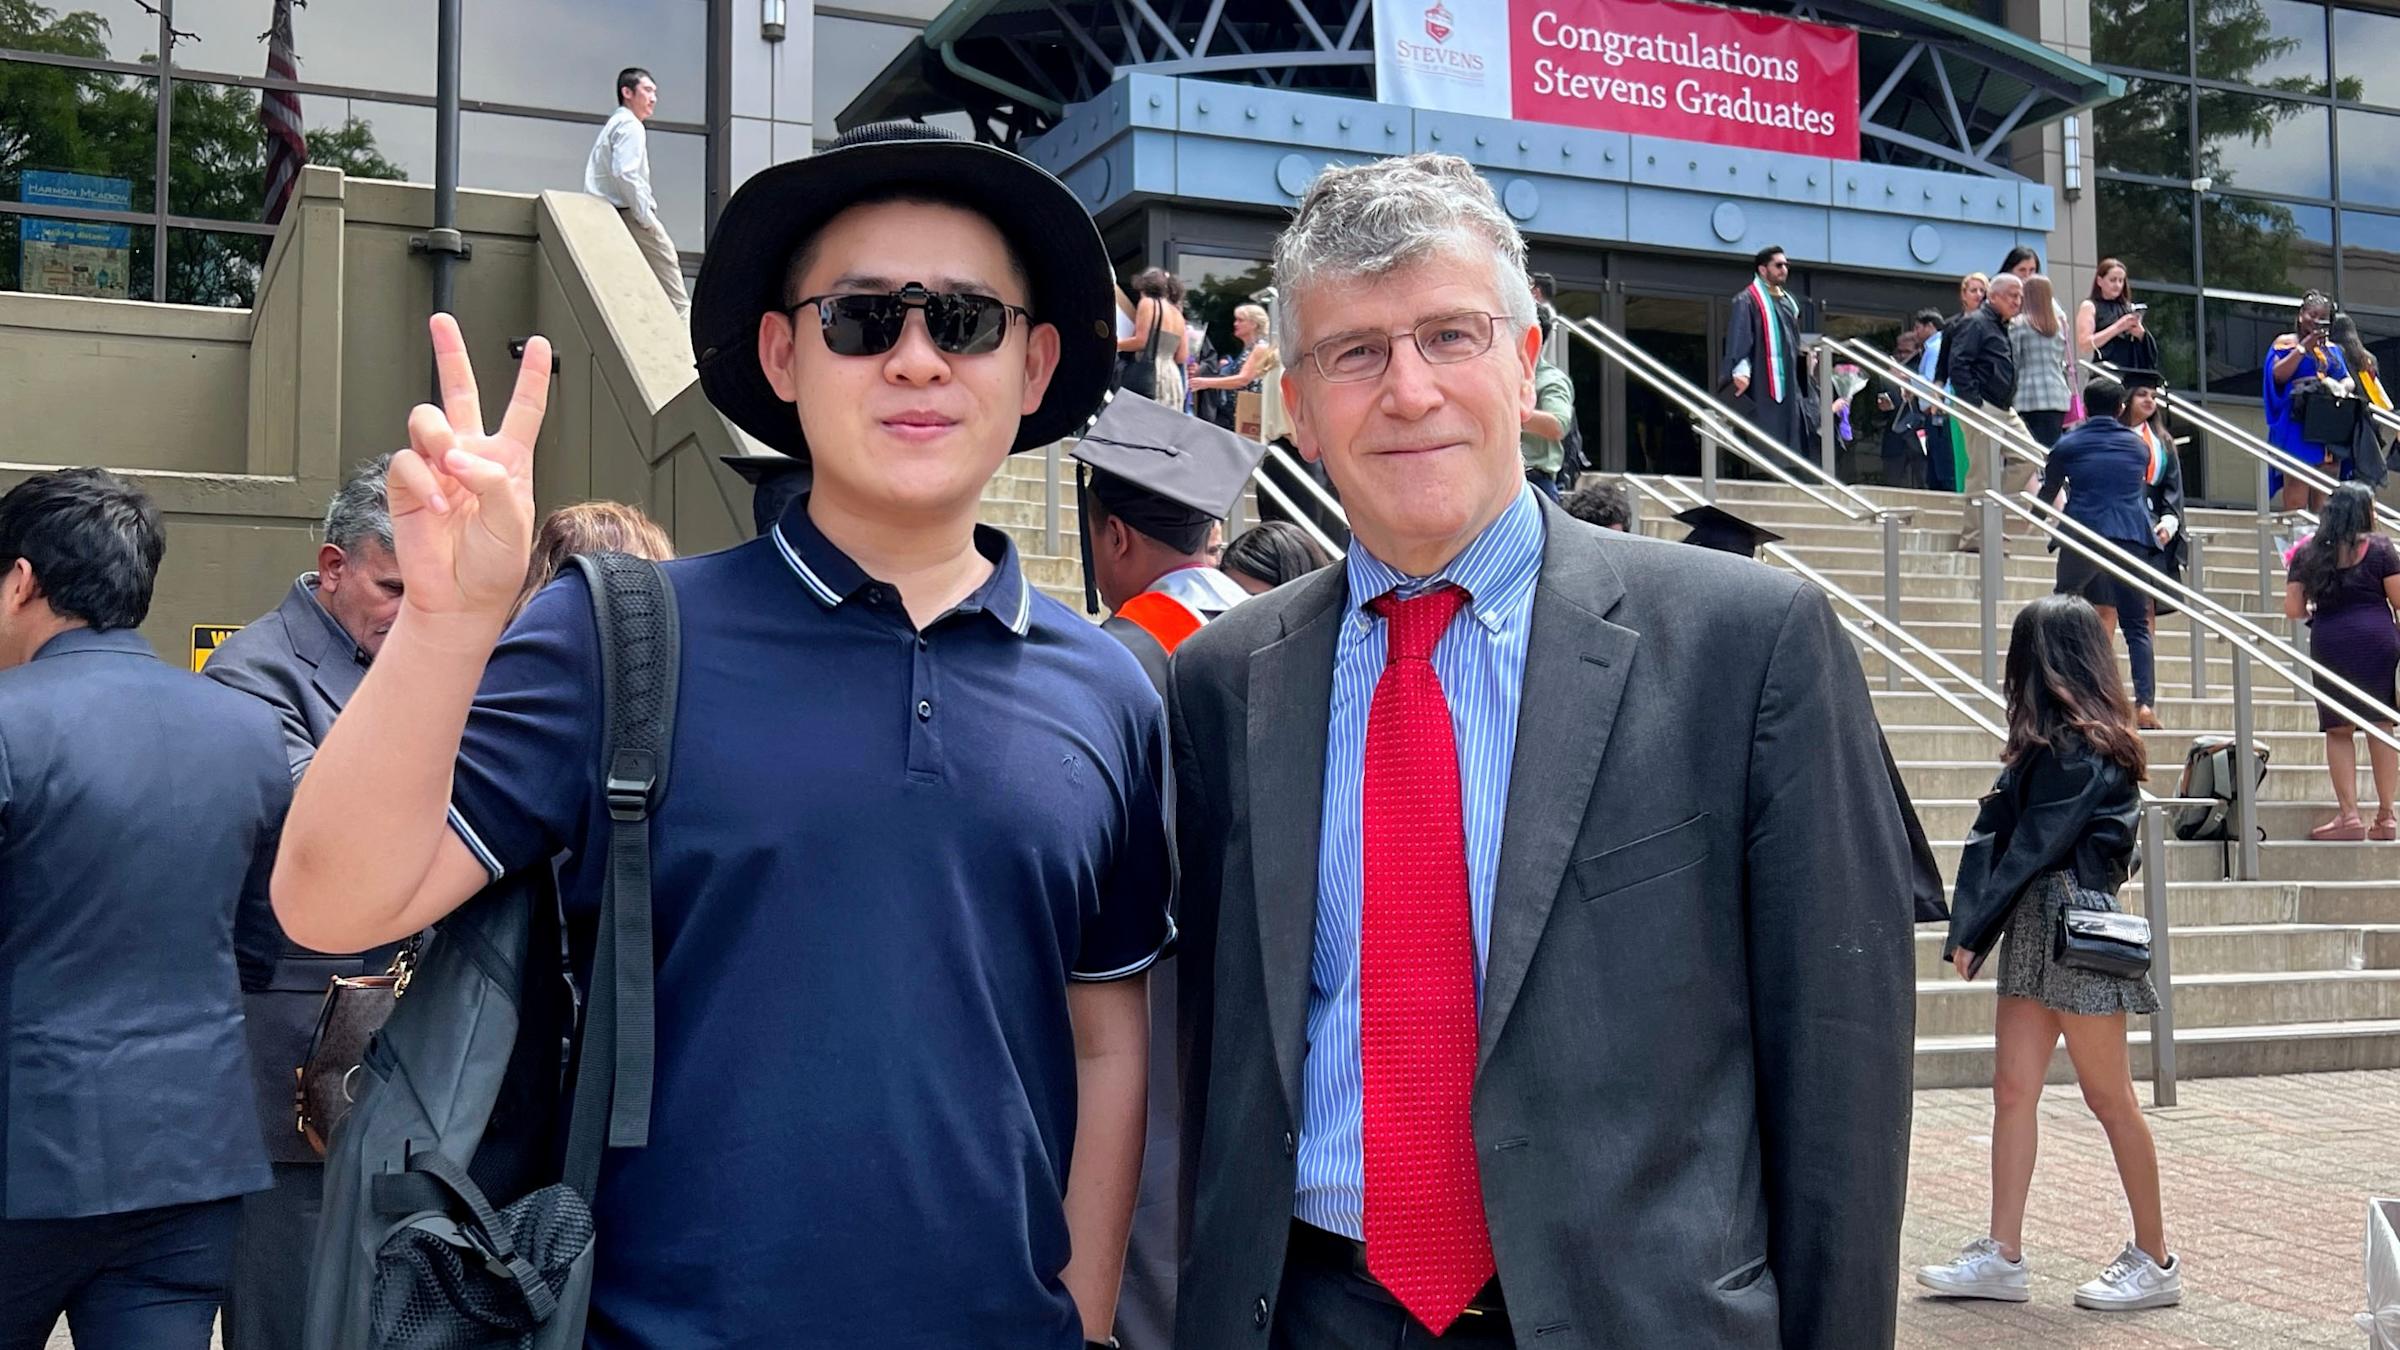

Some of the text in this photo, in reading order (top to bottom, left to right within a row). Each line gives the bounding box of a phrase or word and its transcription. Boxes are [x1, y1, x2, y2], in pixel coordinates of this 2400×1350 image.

[1397, 40, 1484, 70] STEVENS
[1532, 10, 1800, 83] Congratulations
[1534, 59, 1836, 136] Stevens Graduates
[29, 184, 128, 202] HARMON MEADOW
